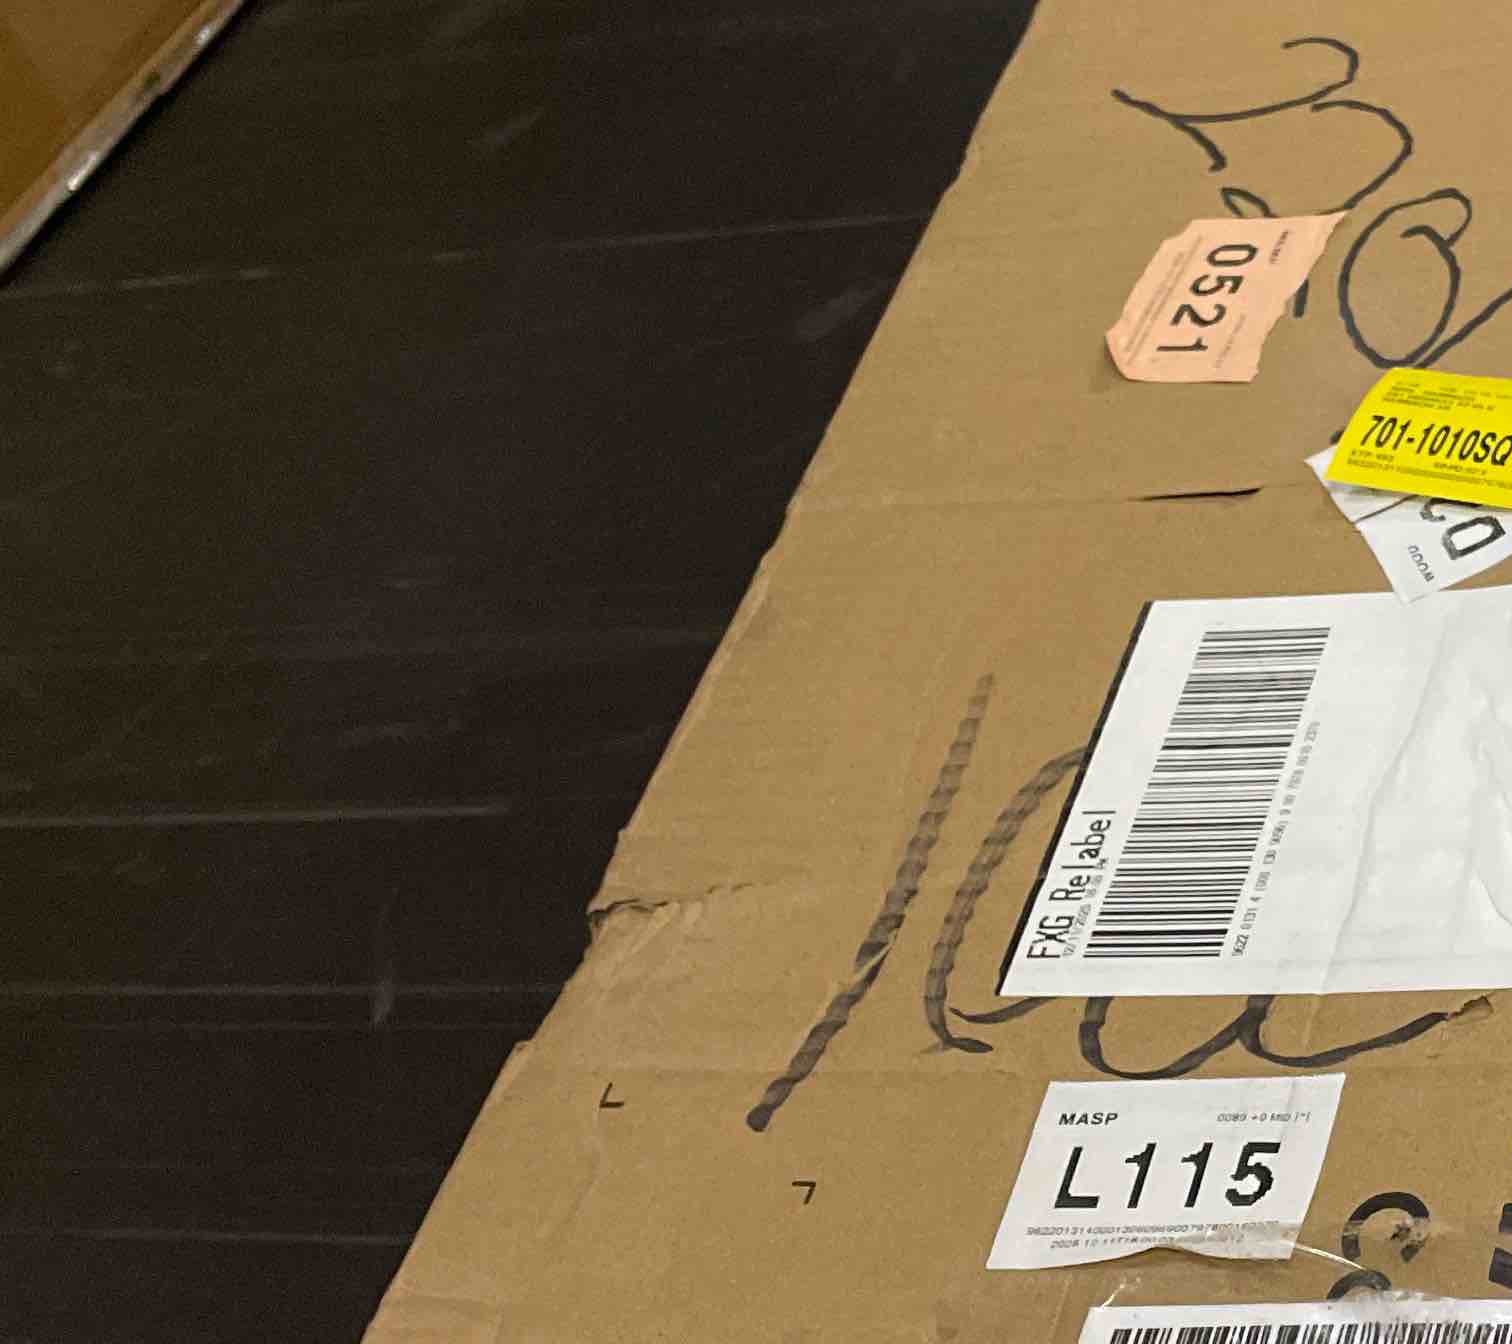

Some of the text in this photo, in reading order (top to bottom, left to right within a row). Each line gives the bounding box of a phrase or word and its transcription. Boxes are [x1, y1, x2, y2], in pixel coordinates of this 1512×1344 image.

[1156, 243, 1259, 353] 0521
[1026, 810, 1118, 959] FXG Relabel
[1058, 1112, 1119, 1126] MASP
[1054, 1141, 1282, 1210] L115
